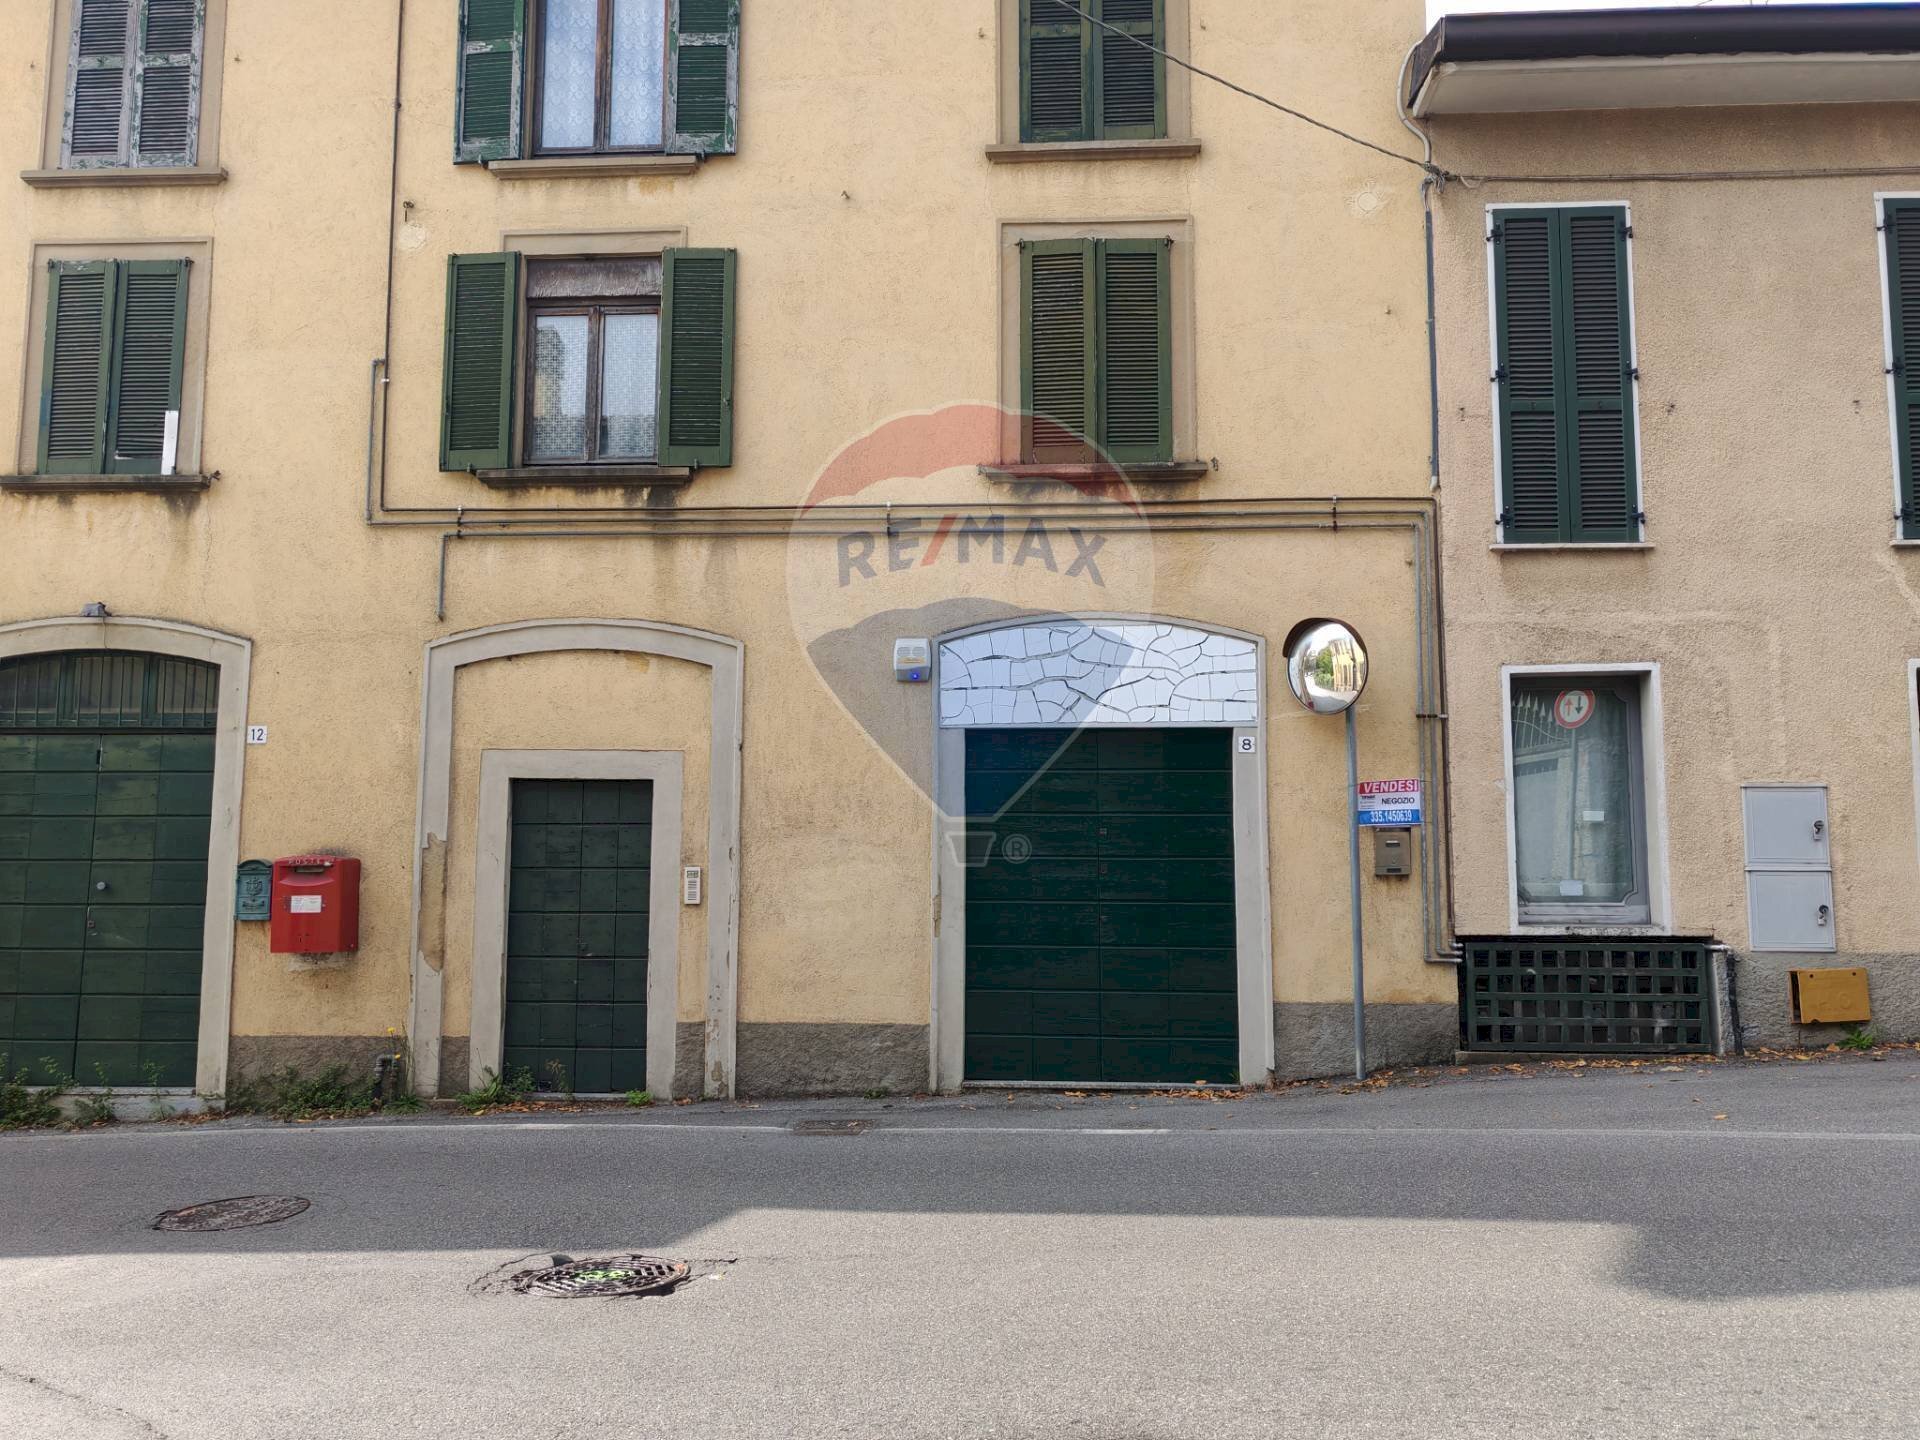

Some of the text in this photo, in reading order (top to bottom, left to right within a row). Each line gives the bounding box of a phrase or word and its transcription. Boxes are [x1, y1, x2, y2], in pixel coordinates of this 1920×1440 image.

[251, 728, 263, 741] 12
[1242, 738, 1251, 750] 8
[1363, 780, 1418, 793] VENDESI
[1381, 797, 1415, 805] NEGOZIO
